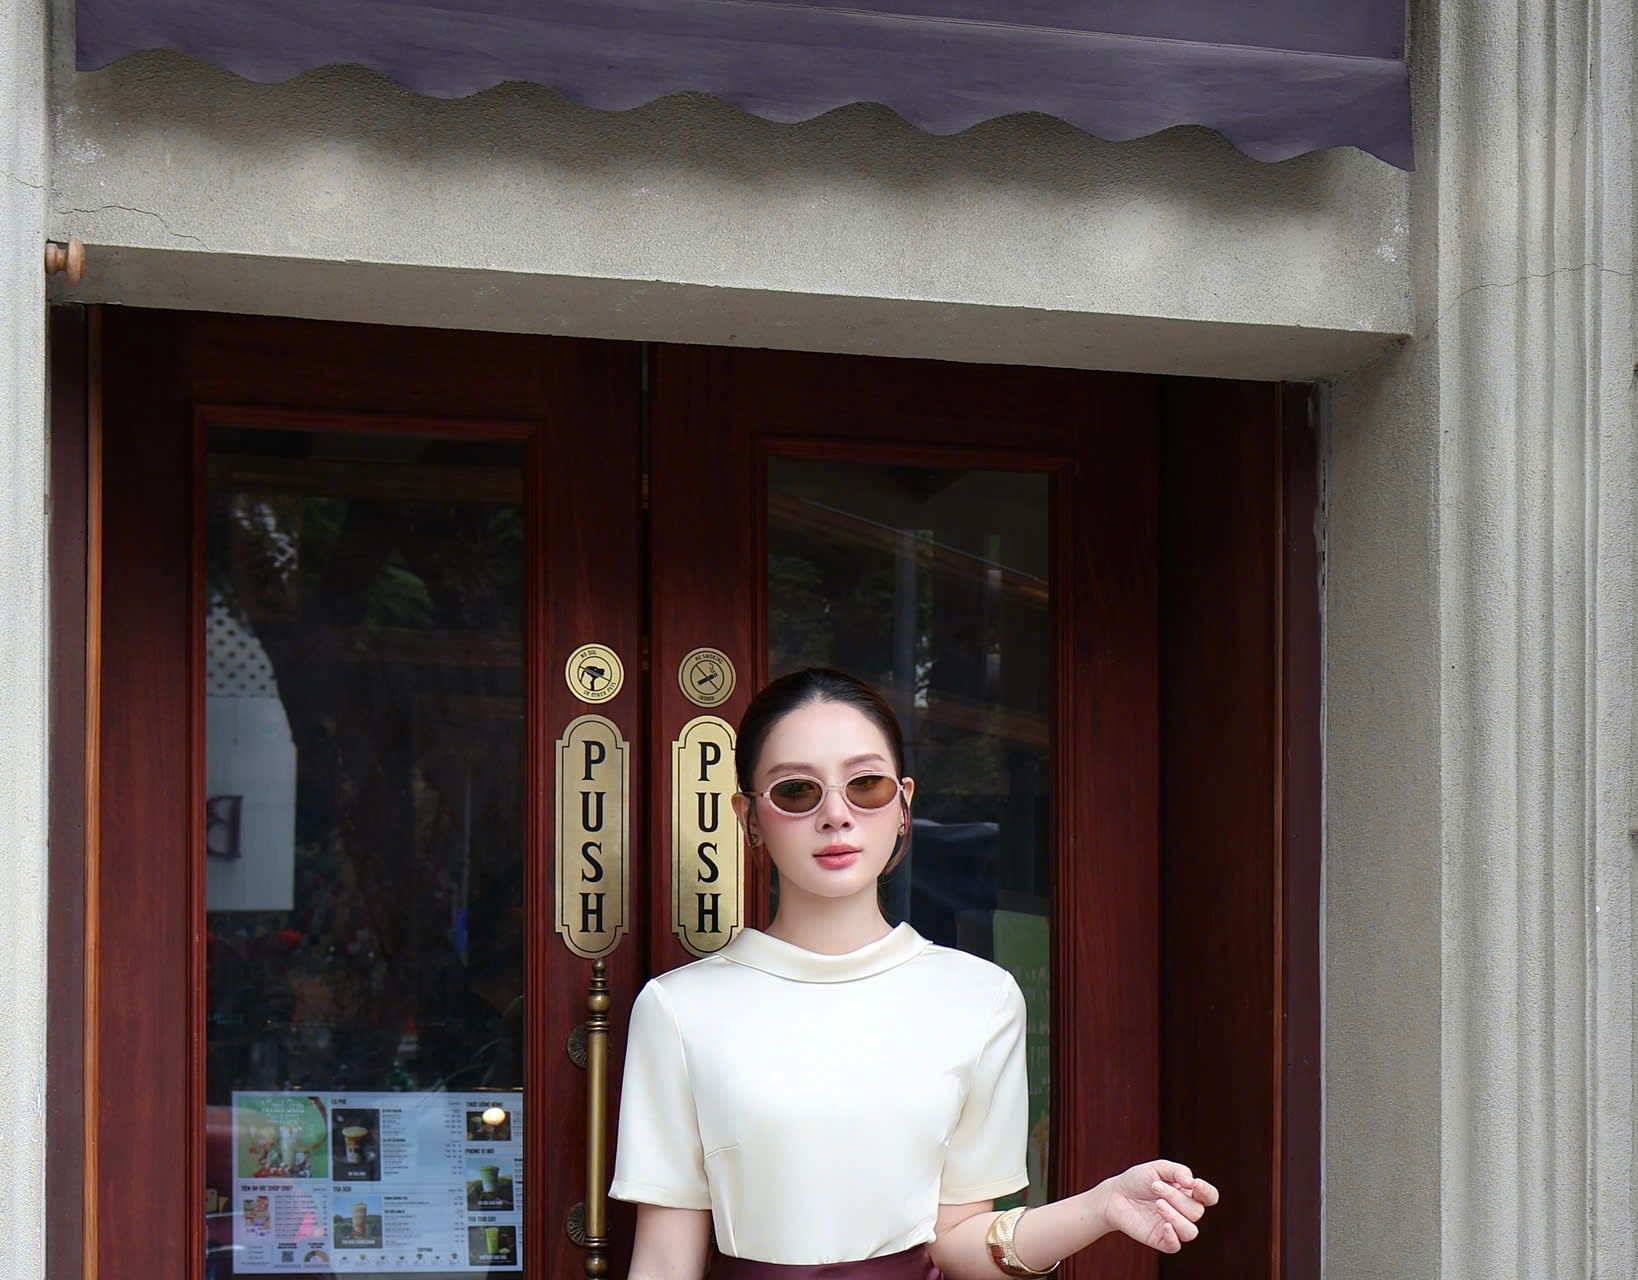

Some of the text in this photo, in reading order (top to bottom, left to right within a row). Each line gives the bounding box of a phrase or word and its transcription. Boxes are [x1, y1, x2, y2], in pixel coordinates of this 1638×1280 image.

[580, 650, 588, 658] NO
[702, 653, 723, 665] SMOKING
[591, 691, 607, 699] OTHER
[607, 682, 617, 693] PETS
[698, 694, 716, 702] INDOOR
[579, 740, 607, 933] PUSH
[695, 741, 722, 934] PUSH
